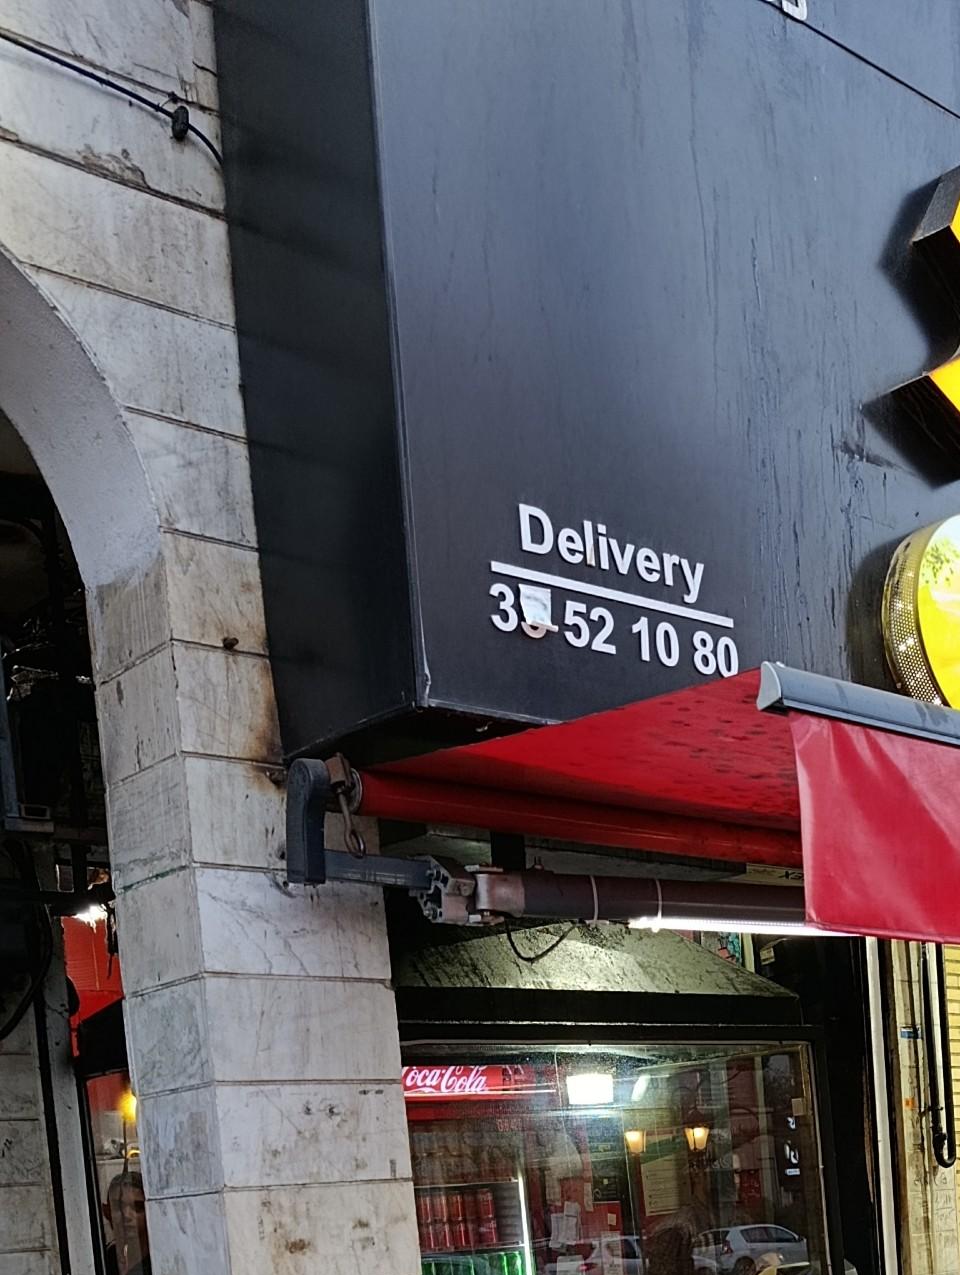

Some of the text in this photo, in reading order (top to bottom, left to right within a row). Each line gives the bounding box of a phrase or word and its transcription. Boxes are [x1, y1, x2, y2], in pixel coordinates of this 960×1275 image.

[518, 503, 704, 604] Delivery
[489, 583, 739, 678] 3 52 10 80
